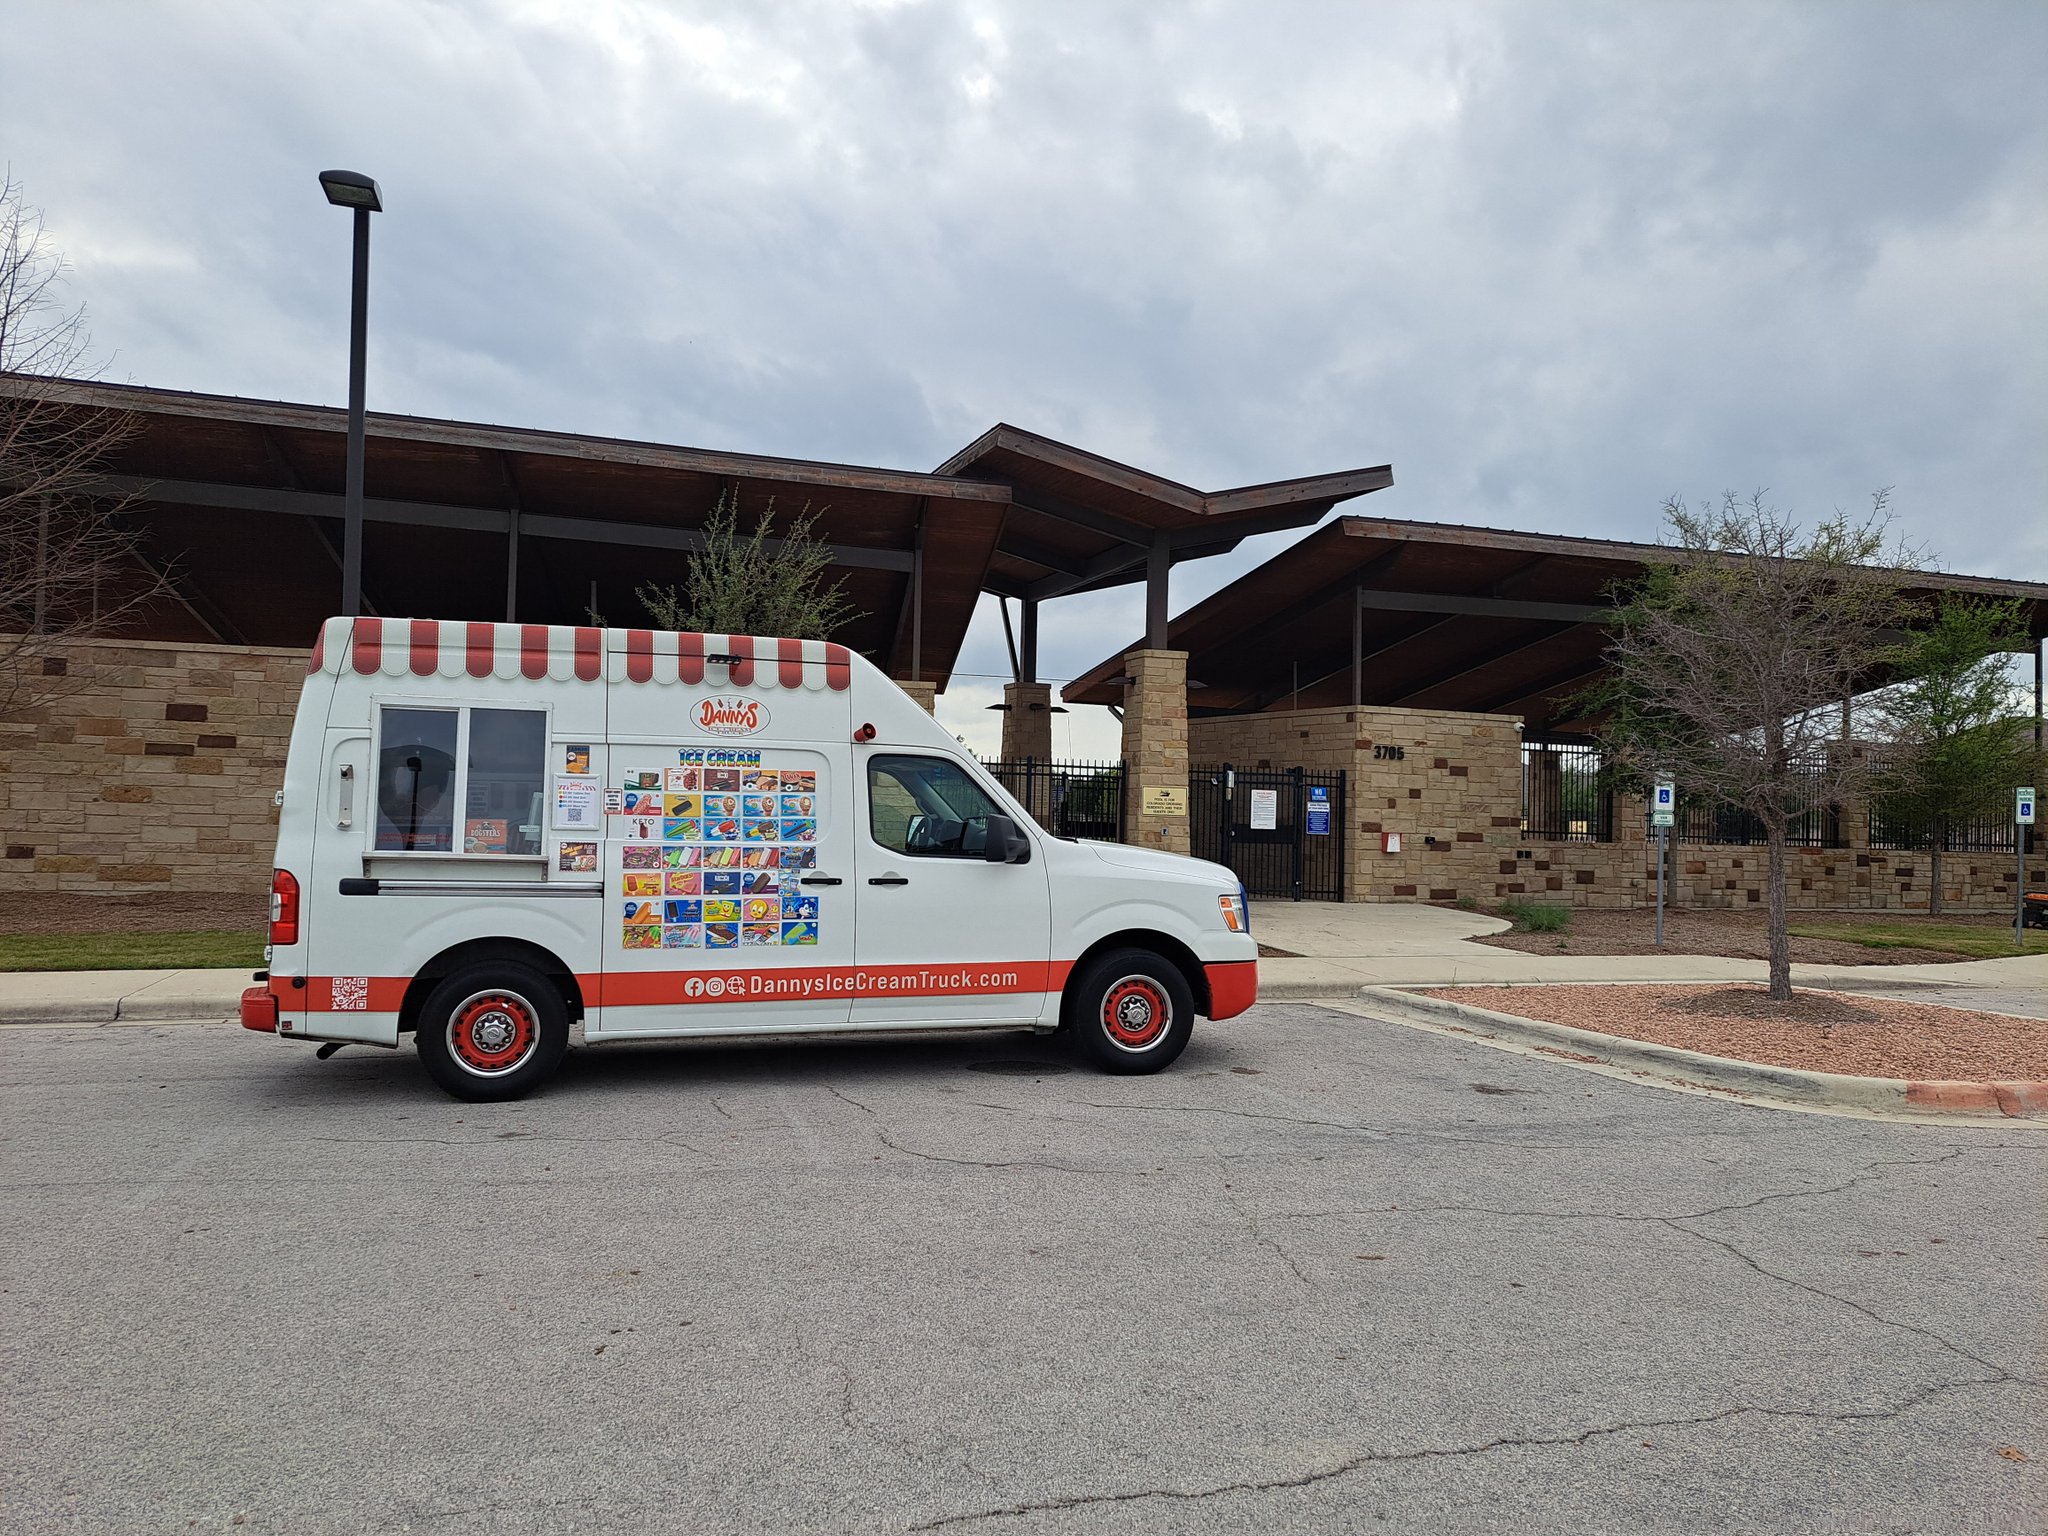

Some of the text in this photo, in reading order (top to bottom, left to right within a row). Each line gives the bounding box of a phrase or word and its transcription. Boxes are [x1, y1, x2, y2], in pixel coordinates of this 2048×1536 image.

[678, 748, 761, 768] ICE CREAM
[1374, 745, 1405, 760] 3705
[471, 829, 501, 837] DOGSTERS
[750, 970, 1017, 996] DannysIceCreamTruck.com
